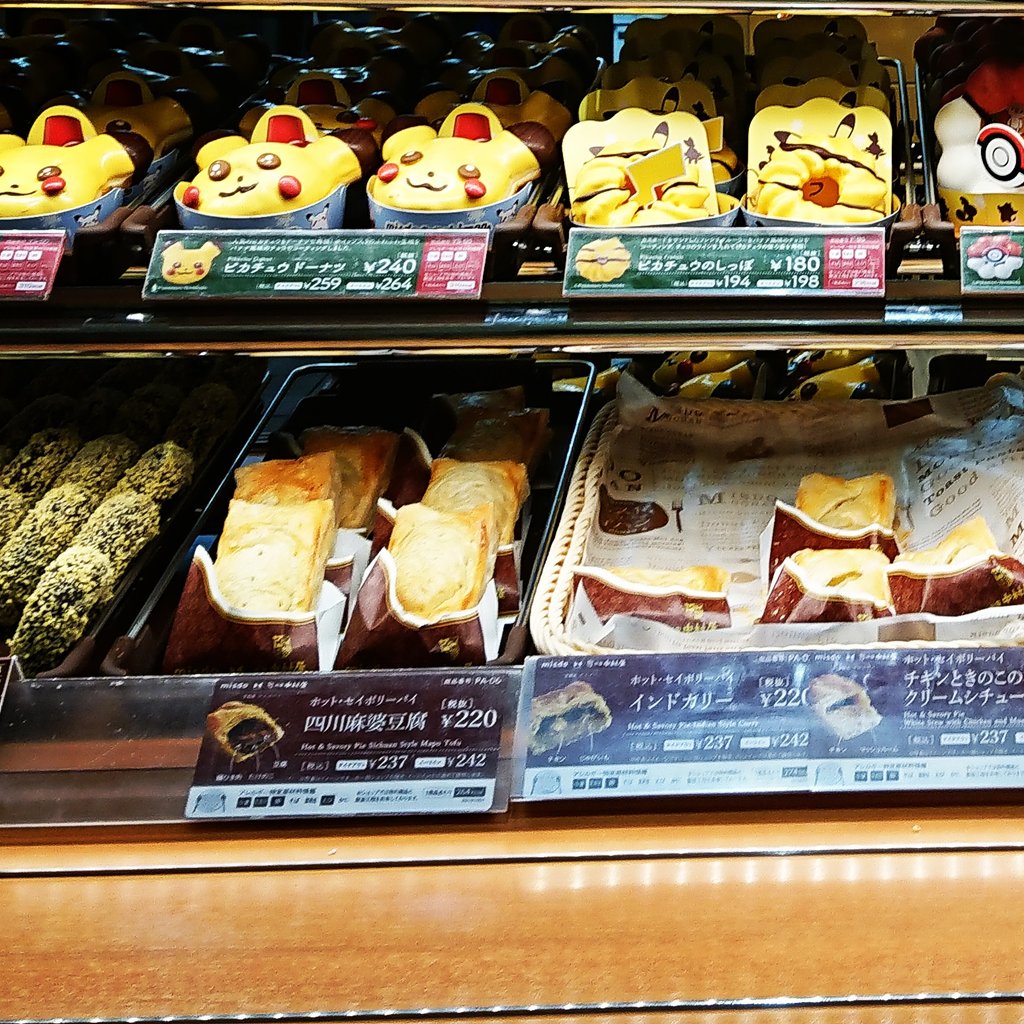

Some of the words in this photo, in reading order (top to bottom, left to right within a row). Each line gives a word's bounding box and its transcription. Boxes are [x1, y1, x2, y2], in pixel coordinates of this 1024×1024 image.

[223, 262, 290, 274] ピカチュウ
[294, 261, 347, 274] ドーナツ
[363, 258, 418, 275] ¥240
[769, 255, 822, 272] ¥180
[302, 277, 343, 291] ¥259
[375, 277, 413, 292] ¥264
[715, 274, 752, 288] ¥194
[783, 274, 821, 289] ¥198
[903, 669, 1024, 688] チキンときのこの
[629, 691, 735, 712] インドカリー
[903, 687, 1024, 708] クリームシチュー
[303, 711, 429, 733] 四川麻婆豆腐
[440, 708, 498, 729] ¥220
[696, 733, 736, 750] ¥237
[971, 728, 1010, 745] ¥237
[368, 754, 409, 770] ¥237
[446, 752, 488, 768] ¥242
